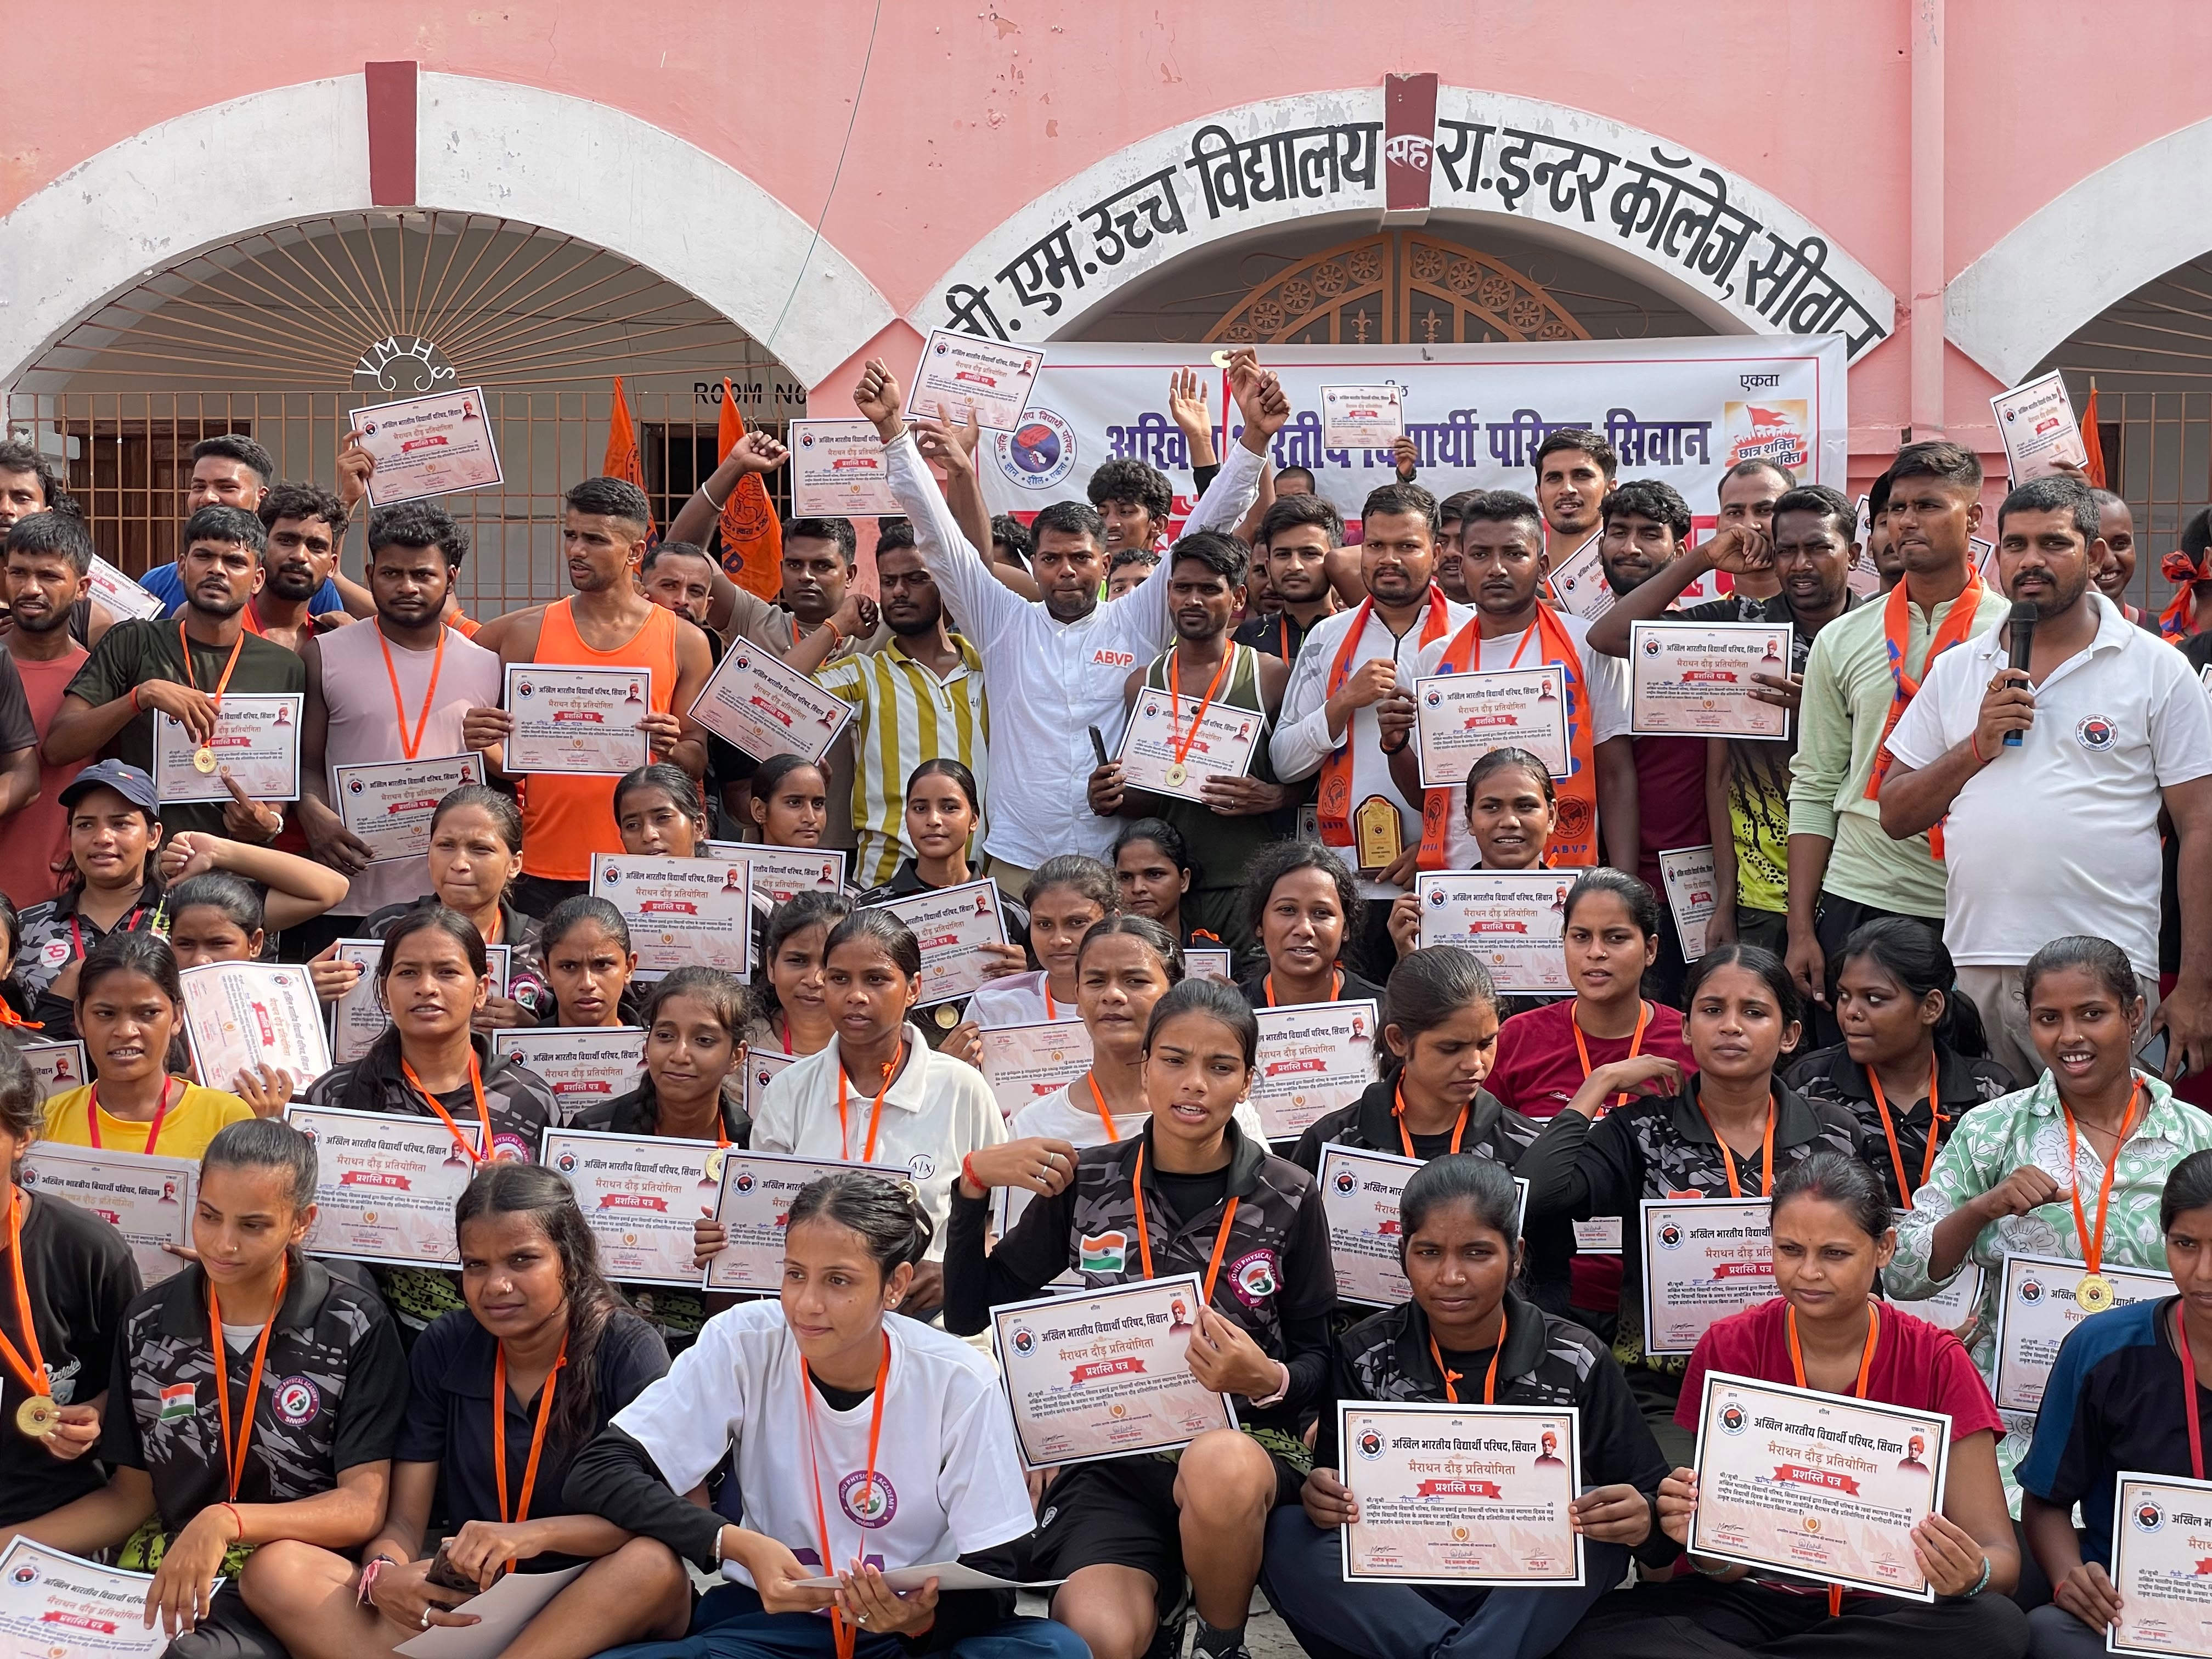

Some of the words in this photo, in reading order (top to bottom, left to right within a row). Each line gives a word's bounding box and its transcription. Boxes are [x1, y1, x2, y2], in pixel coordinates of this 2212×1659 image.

[1386, 135, 1432, 170] सह
[1079, 165, 1188, 267] उच्च
[1184, 122, 1384, 219] विद्यालय
[1740, 375, 1780, 391] एकता
[381, 421, 398, 429] अखिल
[398, 417, 415, 426] भारतीय
[415, 413, 432, 423] विद्यार्थी
[425, 424, 453, 434] प्रतियोगिता
[410, 439, 428, 448] प्रशस्ति
[1739, 446, 1762, 459] छात्र
[1764, 438, 1796, 454] शक्ति
[1026, 475, 1044, 486] शील
[1666, 644, 1685, 652] अखिल
[1686, 644, 1707, 652] भारतीय
[1708, 644, 1728, 652] विद्यार्थी
[1728, 645, 1746, 654] परिषद,
[1094, 650, 1133, 666] ABVP
[1676, 657, 1699, 667] मैराथन
[1701, 658, 1713, 668] दौड़
[1715, 659, 1748, 668] प्रतियोगिता
[576, 686, 594, 695] विद्यार्थी
[595, 687, 611, 696] परिषद,
[548, 698, 568, 707] मैराथन
[570, 699, 582, 709] दौड़
[583, 701, 613, 709] प्रतियोगिता
[1552, 844, 1588, 853] ABVP
[625, 871, 645, 880] अखिल
[646, 872, 666, 881] भारतीय
[667, 872, 687, 882] विद्यार्थी
[688, 873, 706, 883] परिषद,
[707, 874, 724, 883] सिवान
[635, 886, 658, 896] मैराथन
[659, 887, 673, 899] दौड़
[674, 888, 708, 898] प्रतियोगिता
[1453, 893, 1472, 901] अखिल
[1473, 893, 1494, 901] भारतीय
[1495, 892, 1516, 901] विद्यार्थी
[1516, 893, 1534, 902] परिषद,
[1536, 893, 1553, 901] सिवान
[653, 901, 674, 910] प्रशस्ति
[1463, 907, 1486, 917] मैराथन
[1488, 907, 1501, 918] दौड़
[1503, 908, 1538, 917] प्रतियोगिता
[1482, 922, 1503, 930] प्रशस्ति
[326, 1135, 351, 1146] अखिल
[351, 1138, 377, 1149] भारतीय
[377, 1139, 403, 1151] विद्यार्थी
[403, 1142, 425, 1154] परिषद,
[426, 1144, 447, 1155] सिवान
[493, 1137, 518, 1145] HYSICAL
[336, 1153, 365, 1166] मैराथन
[367, 1156, 383, 1170] दौड़
[385, 1159, 427, 1172] प्रतियोगिता
[584, 1159, 608, 1170] अखिल
[608, 1161, 633, 1171] भारतीय
[634, 1162, 659, 1173] विद्यार्थी
[659, 1164, 680, 1176] परिषद,
[681, 1166, 701, 1177] सिवान
[356, 1173, 383, 1183] प्रशस्ति
[595, 1177, 622, 1189] मैराथन
[624, 1179, 640, 1192] दौड़
[642, 1181, 682, 1193] प्रतियोगिता
[614, 1196, 640, 1205] प्रशस्ति
[1231, 1263, 1242, 1282] SONU
[1240, 1253, 1272, 1265] PHYSICAL
[1041, 1329, 1066, 1342] अखिल
[1066, 1324, 1093, 1338] भारतीय
[1094, 1318, 1120, 1334] विद्यार्थी
[1121, 1317, 1146, 1329] परिषद,
[1146, 1313, 1169, 1325] सिवान
[1058, 1348, 1088, 1361] मैराथन
[1090, 1344, 1107, 1357] दौड़
[1109, 1337, 1154, 1353] प्रतियोगिता
[1086, 1362, 1114, 1375] प्रशस्ति
[1116, 1361, 1128, 1370] पत्र
[285, 1416, 307, 1424] SIWAN
[1754, 1417, 1783, 1432] अखिल
[1785, 1423, 1815, 1438] भारतीय
[1817, 1426, 1848, 1443] विद्यार्थी
[1848, 1434, 1875, 1451] परिषद,
[1877, 1438, 1903, 1454] सिवान
[1392, 1437, 1420, 1449] अखिल
[1421, 1438, 1451, 1450] भारतीय
[1453, 1438, 1482, 1451] विद्यार्थी
[1483, 1439, 1510, 1453] परिषद,
[1511, 1440, 1536, 1452] सिवान
[1767, 1440, 1802, 1459] मैराथन
[1804, 1448, 1824, 1466] दौड़
[1826, 1453, 1878, 1474] प्रतियोगिता
[1407, 1459, 1441, 1472] मैराथन
[1444, 1460, 1463, 1476] दौड़
[1465, 1461, 1515, 1475] प्रतियोगिता
[1792, 1469, 1824, 1483] प्रशस्ति
[1827, 1476, 1842, 1486] पत्र
[877, 1478, 895, 1510] ACADEMY
[1435, 1481, 1466, 1492] प्रशस्ति
[1469, 1485, 1483, 1493] पत्र
